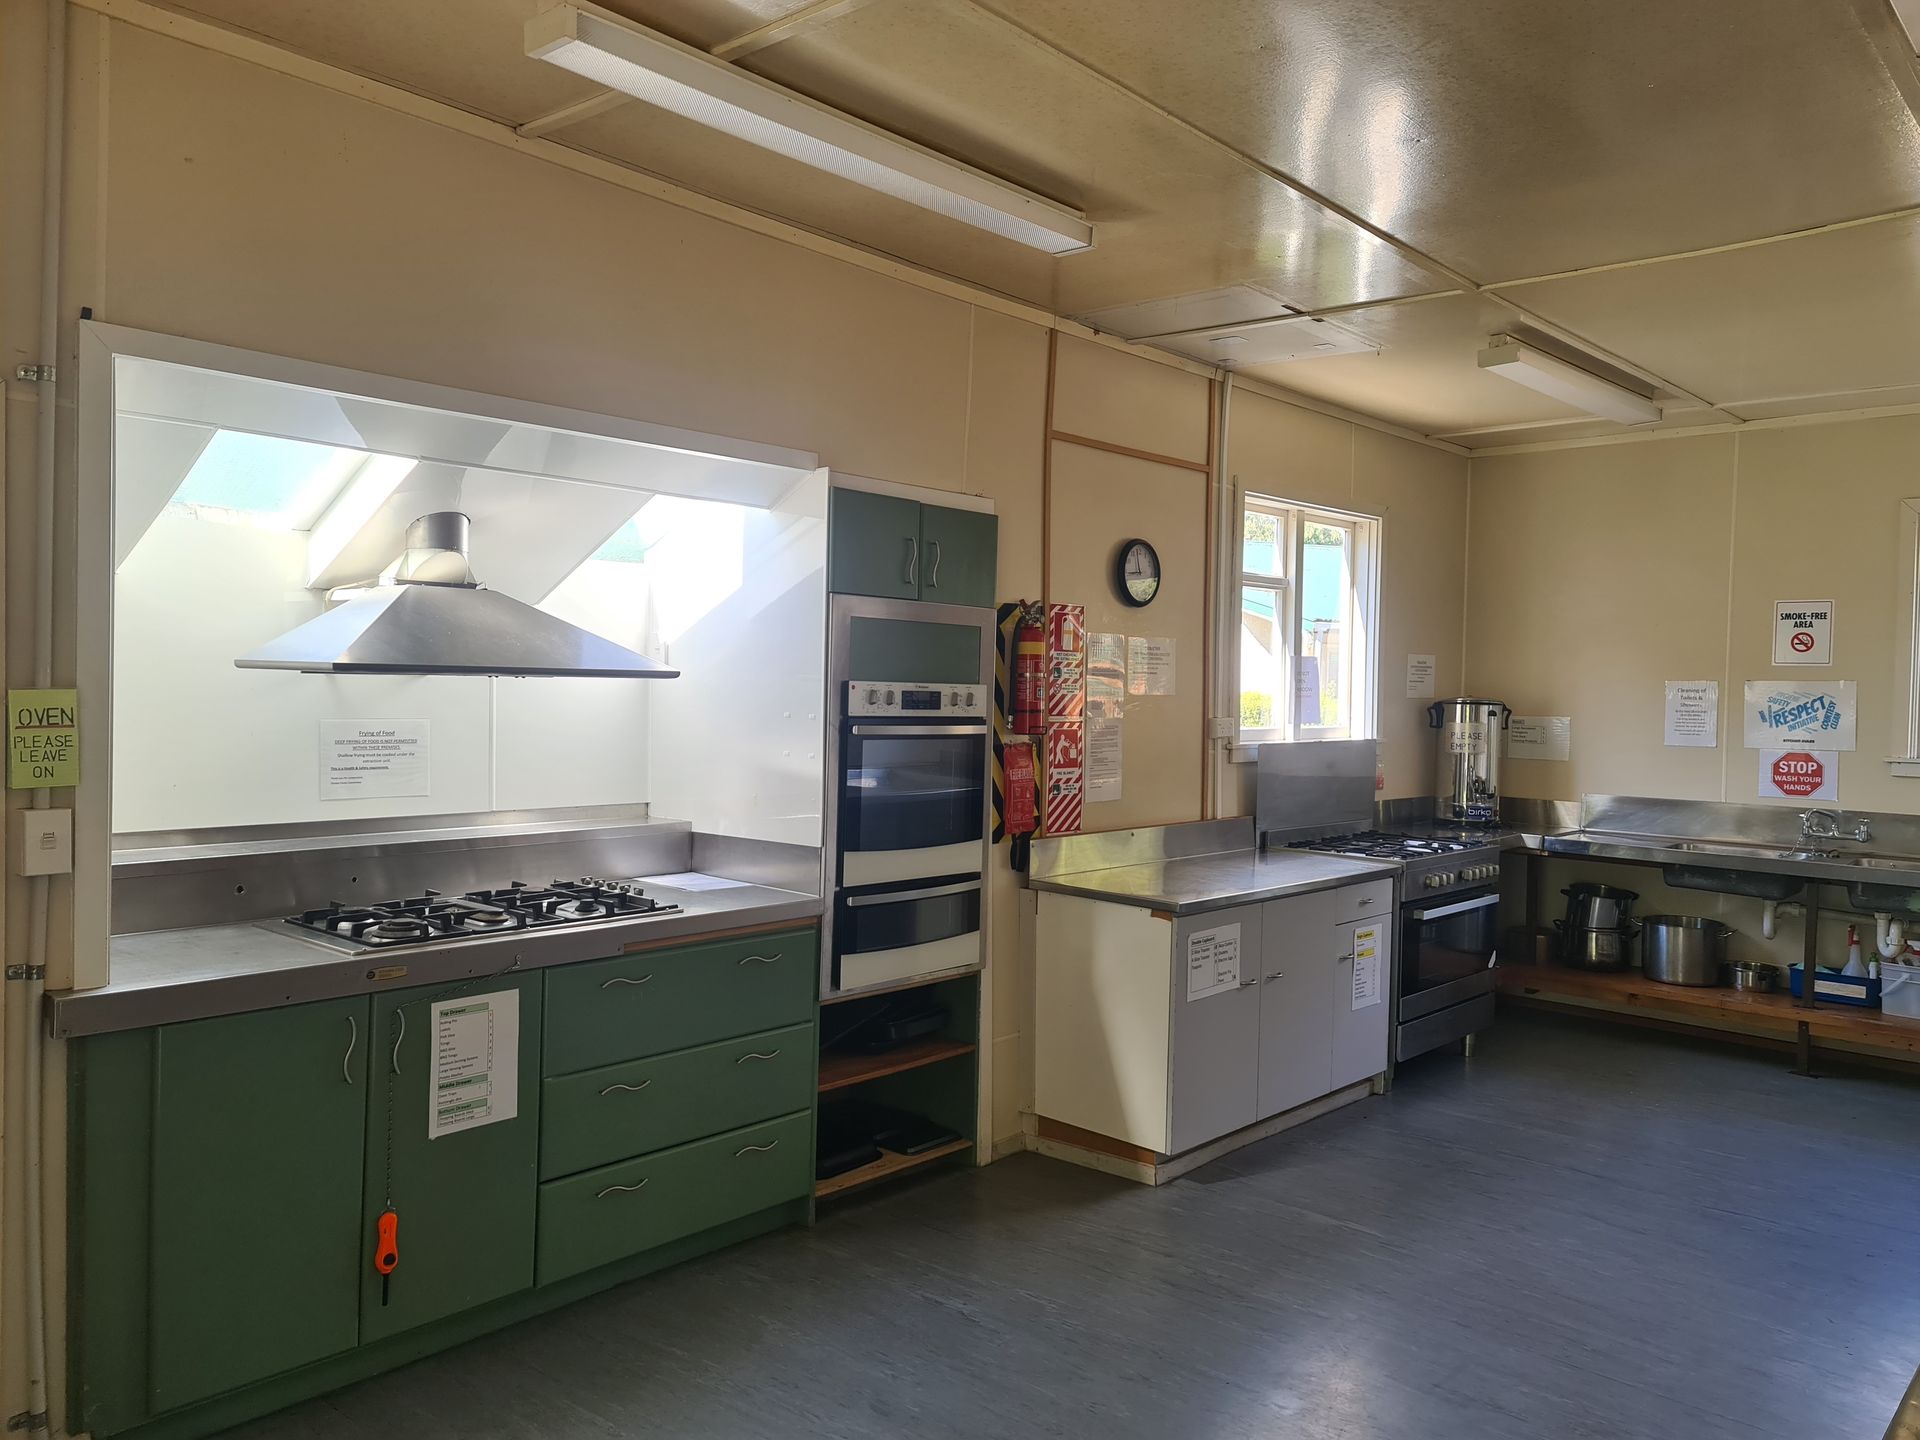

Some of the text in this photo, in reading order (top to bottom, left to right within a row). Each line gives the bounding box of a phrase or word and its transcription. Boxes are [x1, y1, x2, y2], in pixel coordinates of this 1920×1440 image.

[1780, 612, 1828, 620] SMOKE-FREE
[1767, 696, 1791, 707] SAFETY
[18, 706, 74, 726] OVEN
[1773, 696, 1826, 728] RESPECT
[1821, 700, 1836, 730] COURTESY
[1788, 714, 1820, 732] INITIATIVE
[14, 734, 74, 749] PLEASE
[1451, 732, 1482, 740] PLEASE
[1451, 742, 1477, 751] EMPTY
[20, 748, 68, 762] LEAVE
[33, 766, 54, 778] ON
[1779, 760, 1817, 774] STOP
[1468, 808, 1491, 816] birko
